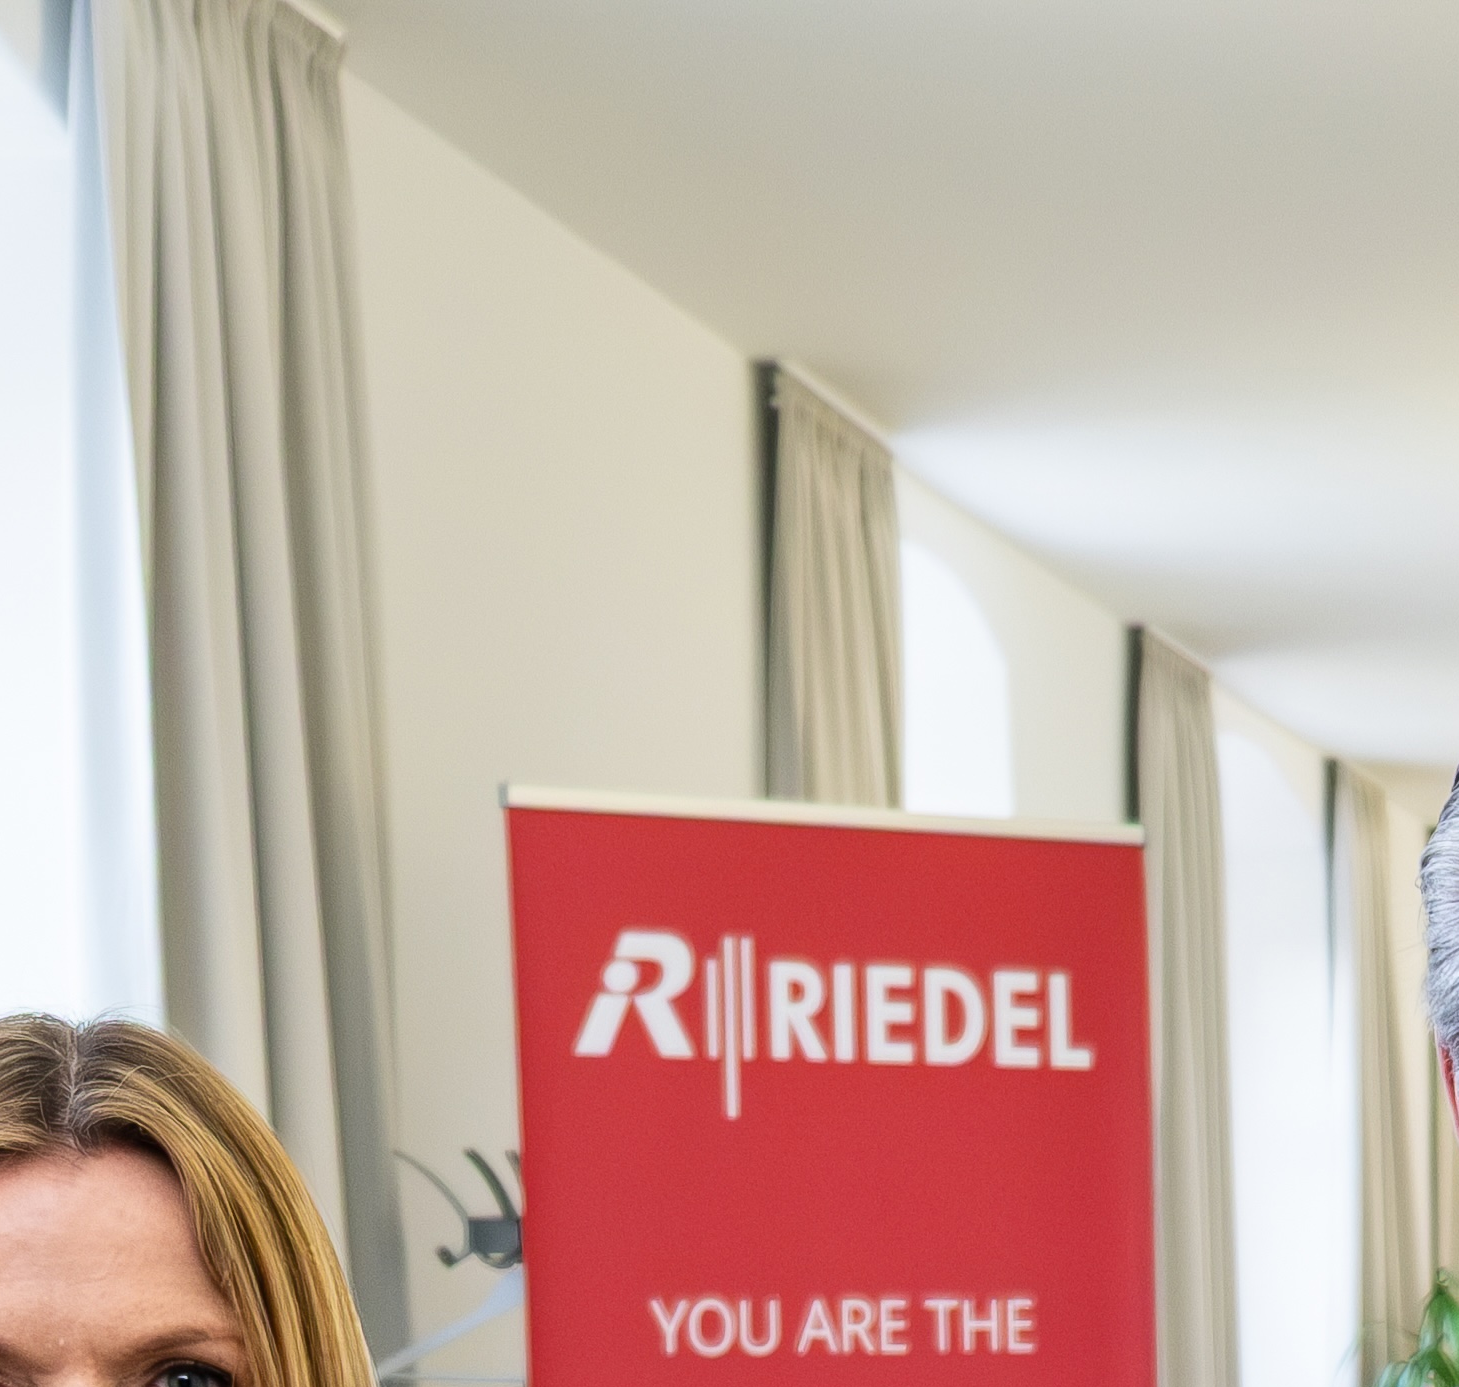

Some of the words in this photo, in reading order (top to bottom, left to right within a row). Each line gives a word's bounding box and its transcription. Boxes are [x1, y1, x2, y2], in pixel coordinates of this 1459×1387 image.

[767, 957, 1094, 1071] RIEDEL
[650, 1298, 781, 1358] YOU
[797, 1299, 909, 1356] ARE
[923, 1297, 1036, 1353] THE
